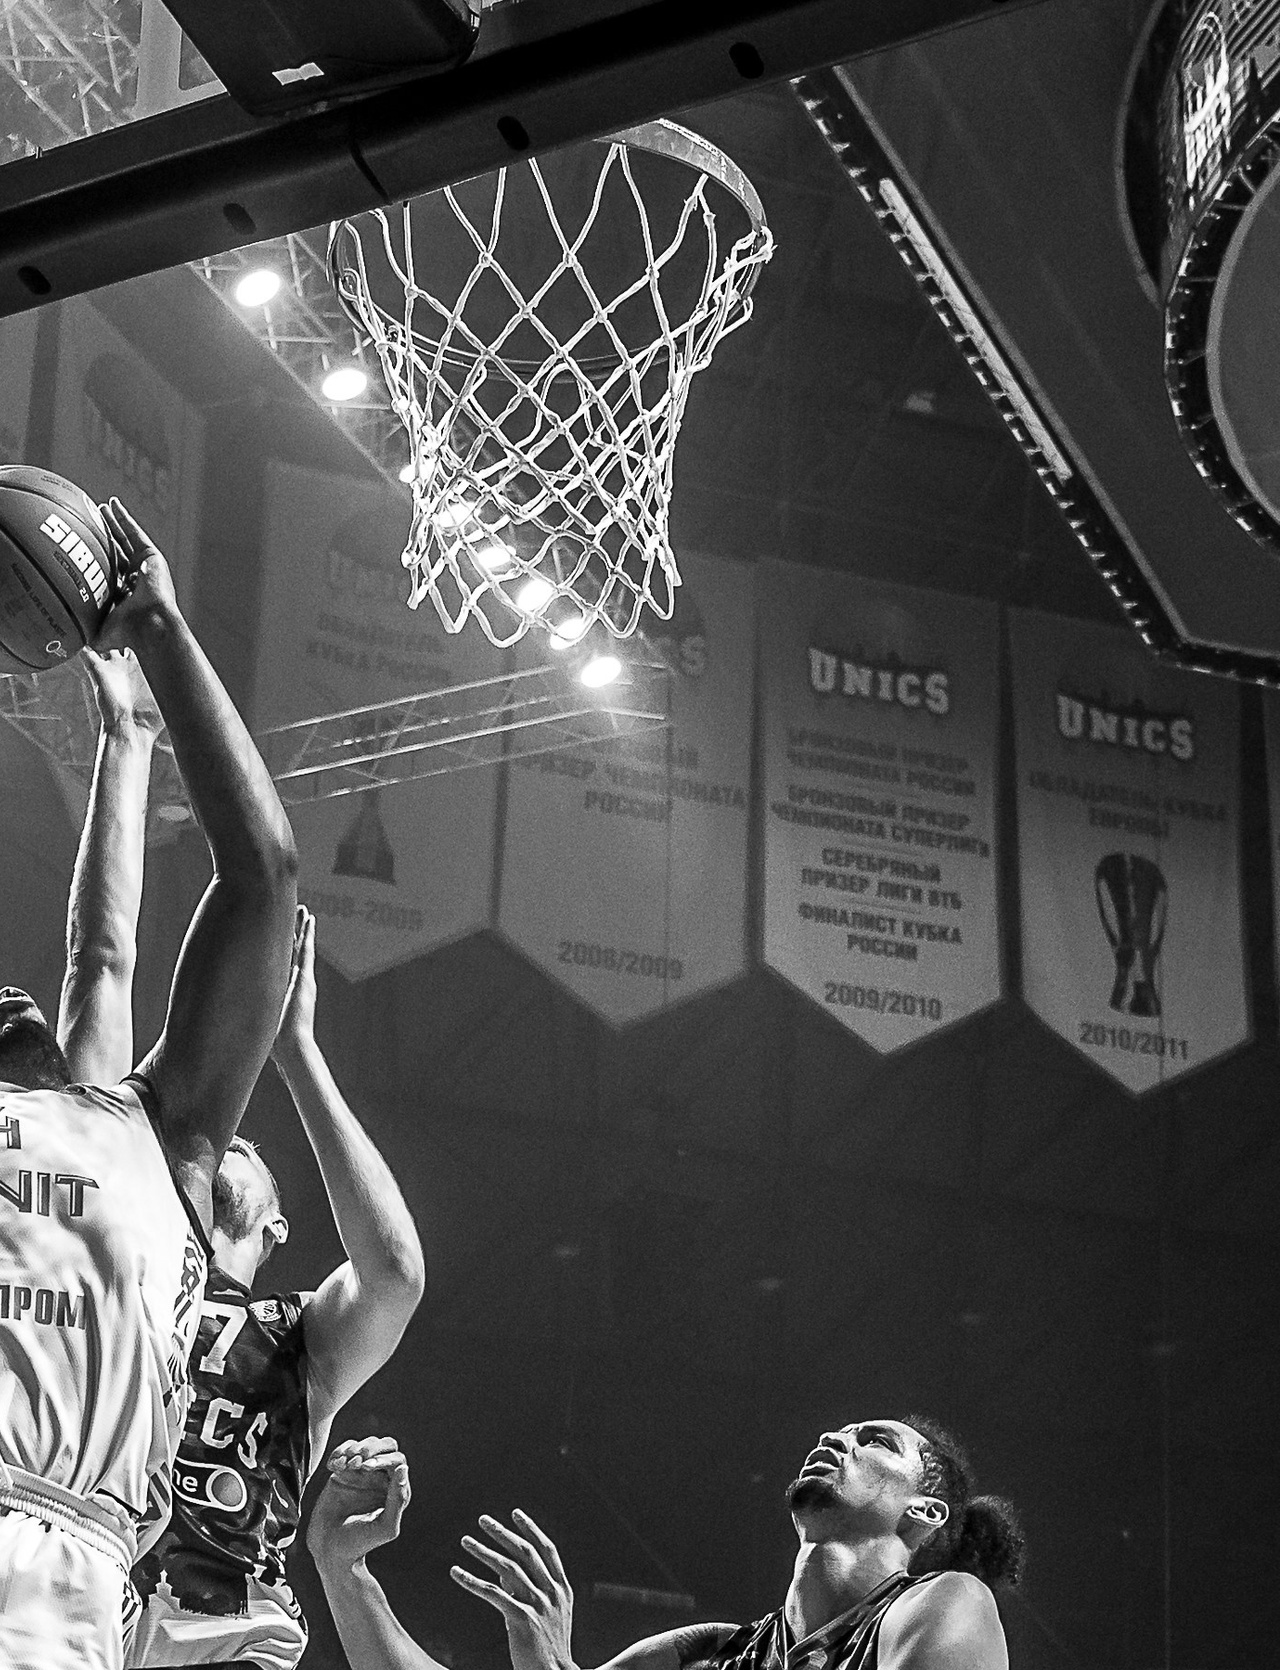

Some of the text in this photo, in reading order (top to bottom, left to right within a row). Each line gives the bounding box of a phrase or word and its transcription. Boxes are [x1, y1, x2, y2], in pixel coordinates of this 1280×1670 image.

[808, 646, 950, 714] UNICS
[1056, 693, 1195, 761] UNICS
[797, 901, 963, 945] ФИНАЛИСТ КУБКА
[846, 933, 919, 962] РОССИИ
[823, 981, 943, 1021] 2009/2010
[1078, 1021, 1190, 1061] 2010/2011
[198, 1300, 248, 1376] 7
